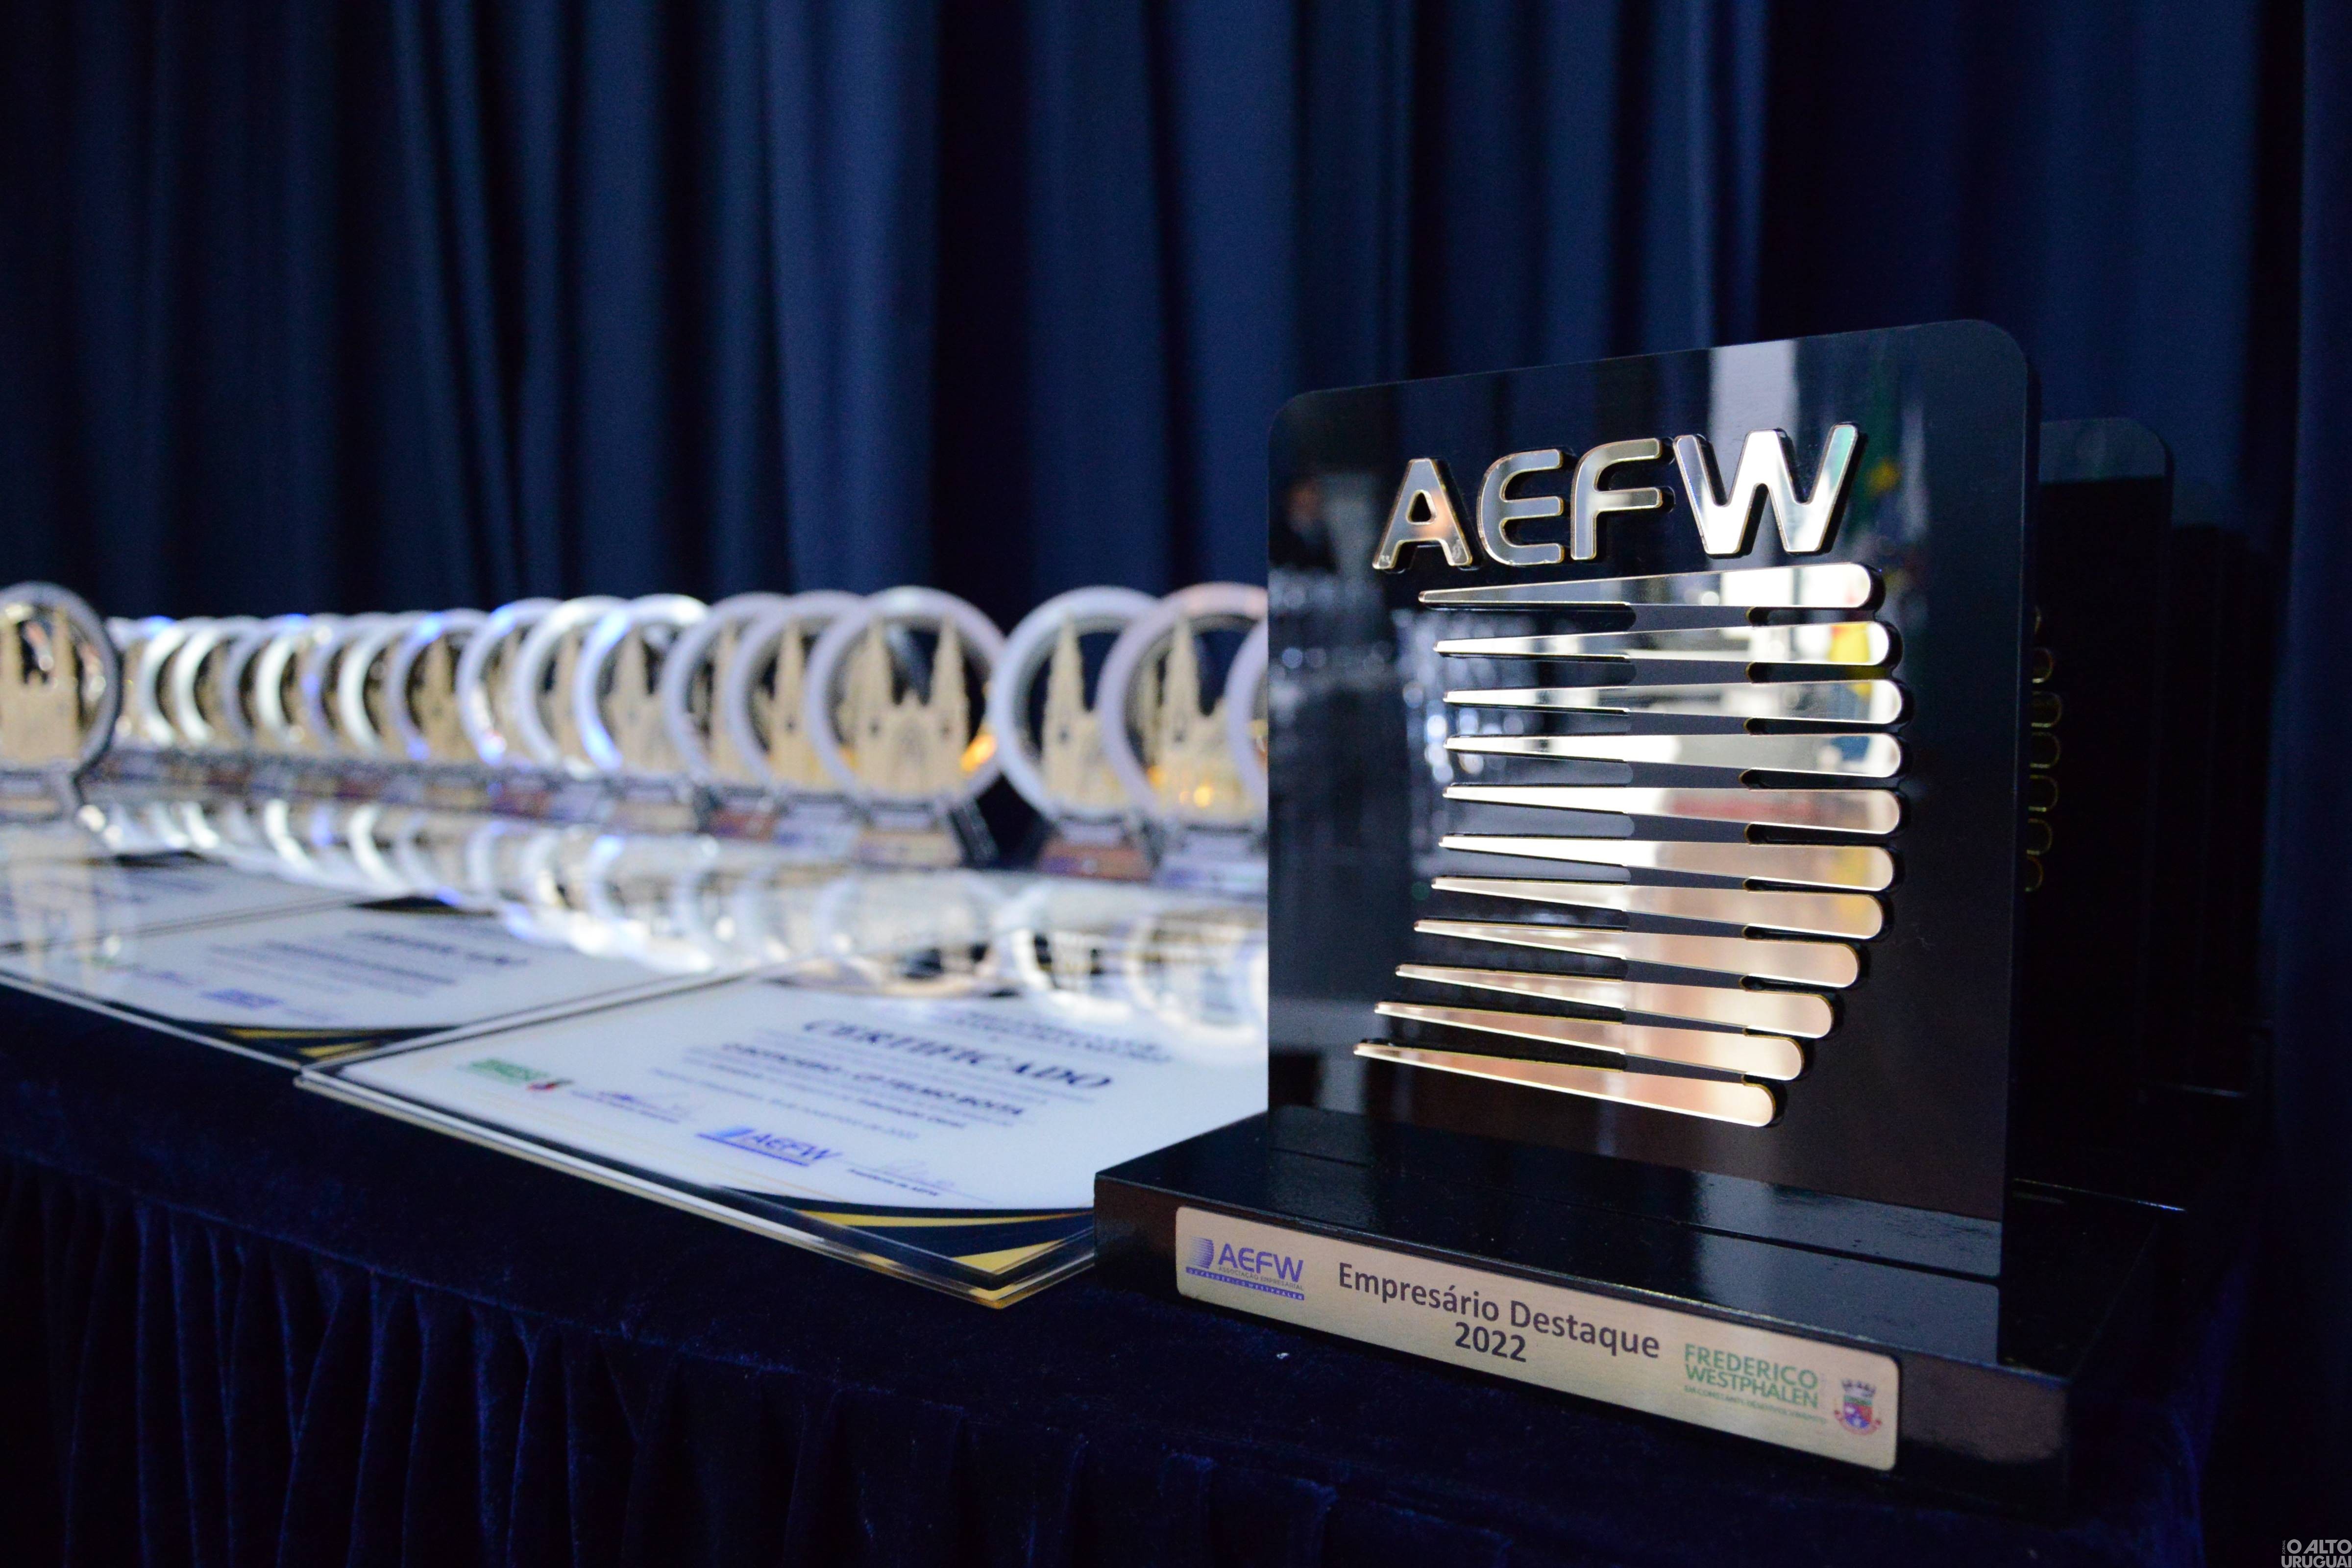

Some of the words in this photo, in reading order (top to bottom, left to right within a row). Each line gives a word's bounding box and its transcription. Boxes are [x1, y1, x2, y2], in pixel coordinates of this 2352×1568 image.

[1372, 423, 1860, 570] AEFW
[1218, 1243, 1303, 1283] AEFW
[1249, 1282, 1302, 1300] WESTPHALEN
[1339, 1262, 1499, 1322] Empresário
[1511, 1300, 1660, 1358] Destaque
[1455, 1322, 1526, 1362] 2022
[1684, 1343, 1818, 1390] FREDERICO
[1685, 1363, 1818, 1409] WESTPHALEN
